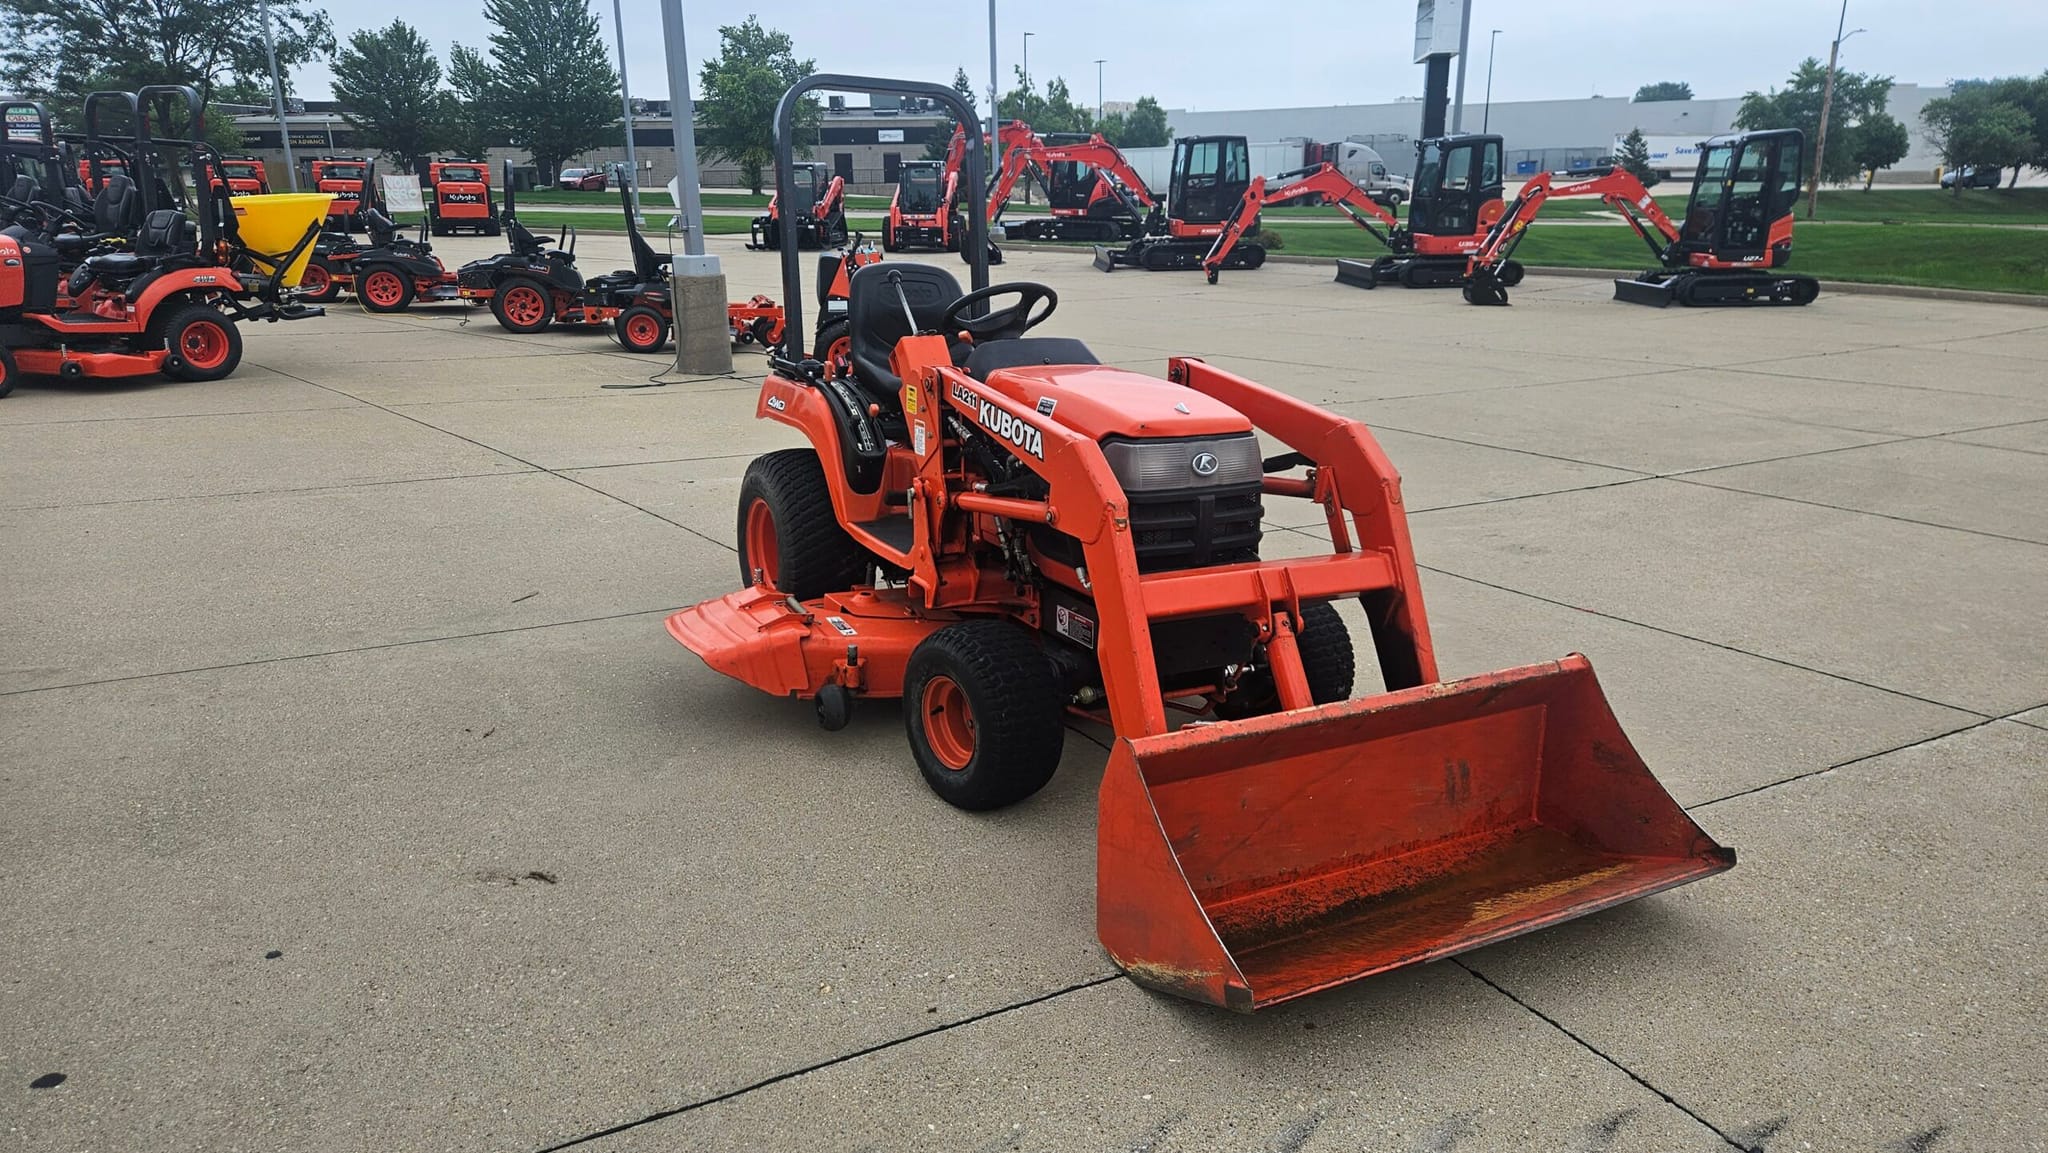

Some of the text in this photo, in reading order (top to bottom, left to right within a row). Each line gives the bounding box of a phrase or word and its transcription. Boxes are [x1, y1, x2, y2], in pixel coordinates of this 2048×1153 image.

[1675, 146, 1695, 154] Save
[449, 193, 477, 201] Kubota
[952, 381, 978, 409] LA211
[768, 396, 785, 410] 4WD
[979, 399, 1044, 460] KUBOTA
